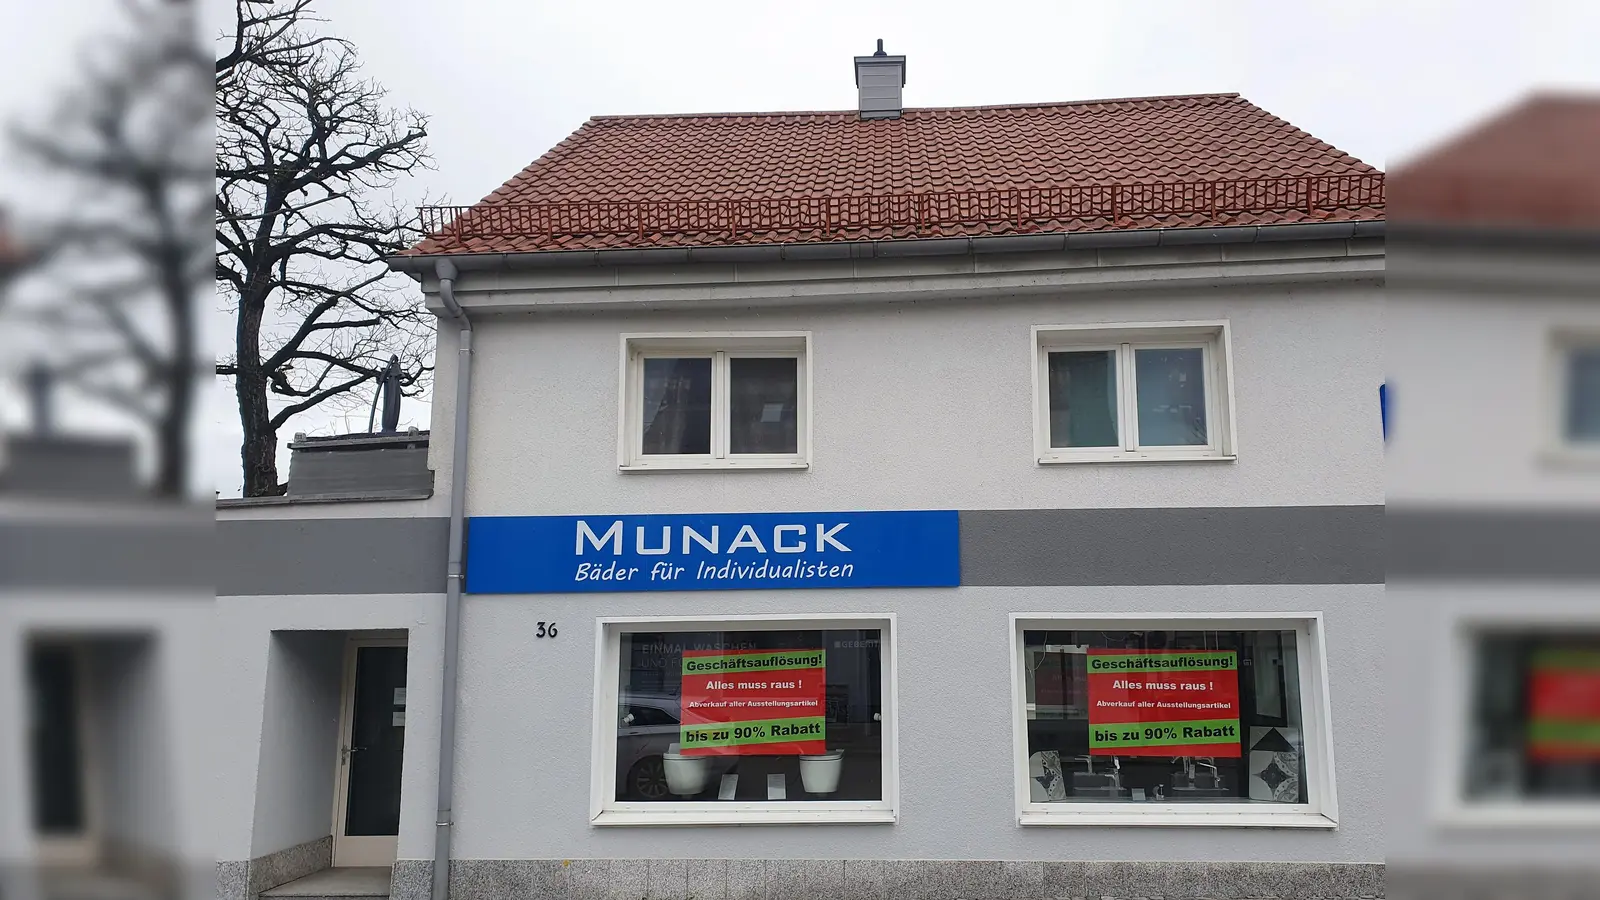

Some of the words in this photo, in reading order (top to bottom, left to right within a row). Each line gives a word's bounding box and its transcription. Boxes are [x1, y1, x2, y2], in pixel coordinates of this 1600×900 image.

[575, 520, 852, 556] MUNACK
[574, 560, 639, 582] Bäder
[651, 561, 685, 581] für
[696, 558, 854, 580] Individualisten
[535, 621, 558, 639] 36
[686, 654, 823, 671] Geschäftsauflösung!
[1091, 655, 1234, 670] Geschäftsauflösung!
[705, 680, 735, 690] Alles
[737, 682, 768, 690] muss
[770, 681, 796, 689] raus
[798, 679, 803, 689] !
[1112, 680, 1143, 690] Alles
[1145, 682, 1177, 690] muss
[1180, 682, 1207, 691] raus
[1209, 681, 1214, 691] !
[688, 700, 728, 708] Abverkauf
[728, 700, 746, 708] aller
[747, 699, 818, 709] Ausstellungsartikel
[1096, 700, 1136, 708] Abverkauf
[1156, 701, 1231, 710] Ausstellungsartikel
[685, 730, 708, 743] bis
[712, 730, 729, 741] zu
[734, 725, 766, 739] 90%
[770, 722, 821, 737] Rabatt
[1095, 730, 1118, 742] bis
[1122, 731, 1140, 741] zu
[1144, 727, 1178, 740] 90%
[1182, 725, 1235, 738] Rabatt
